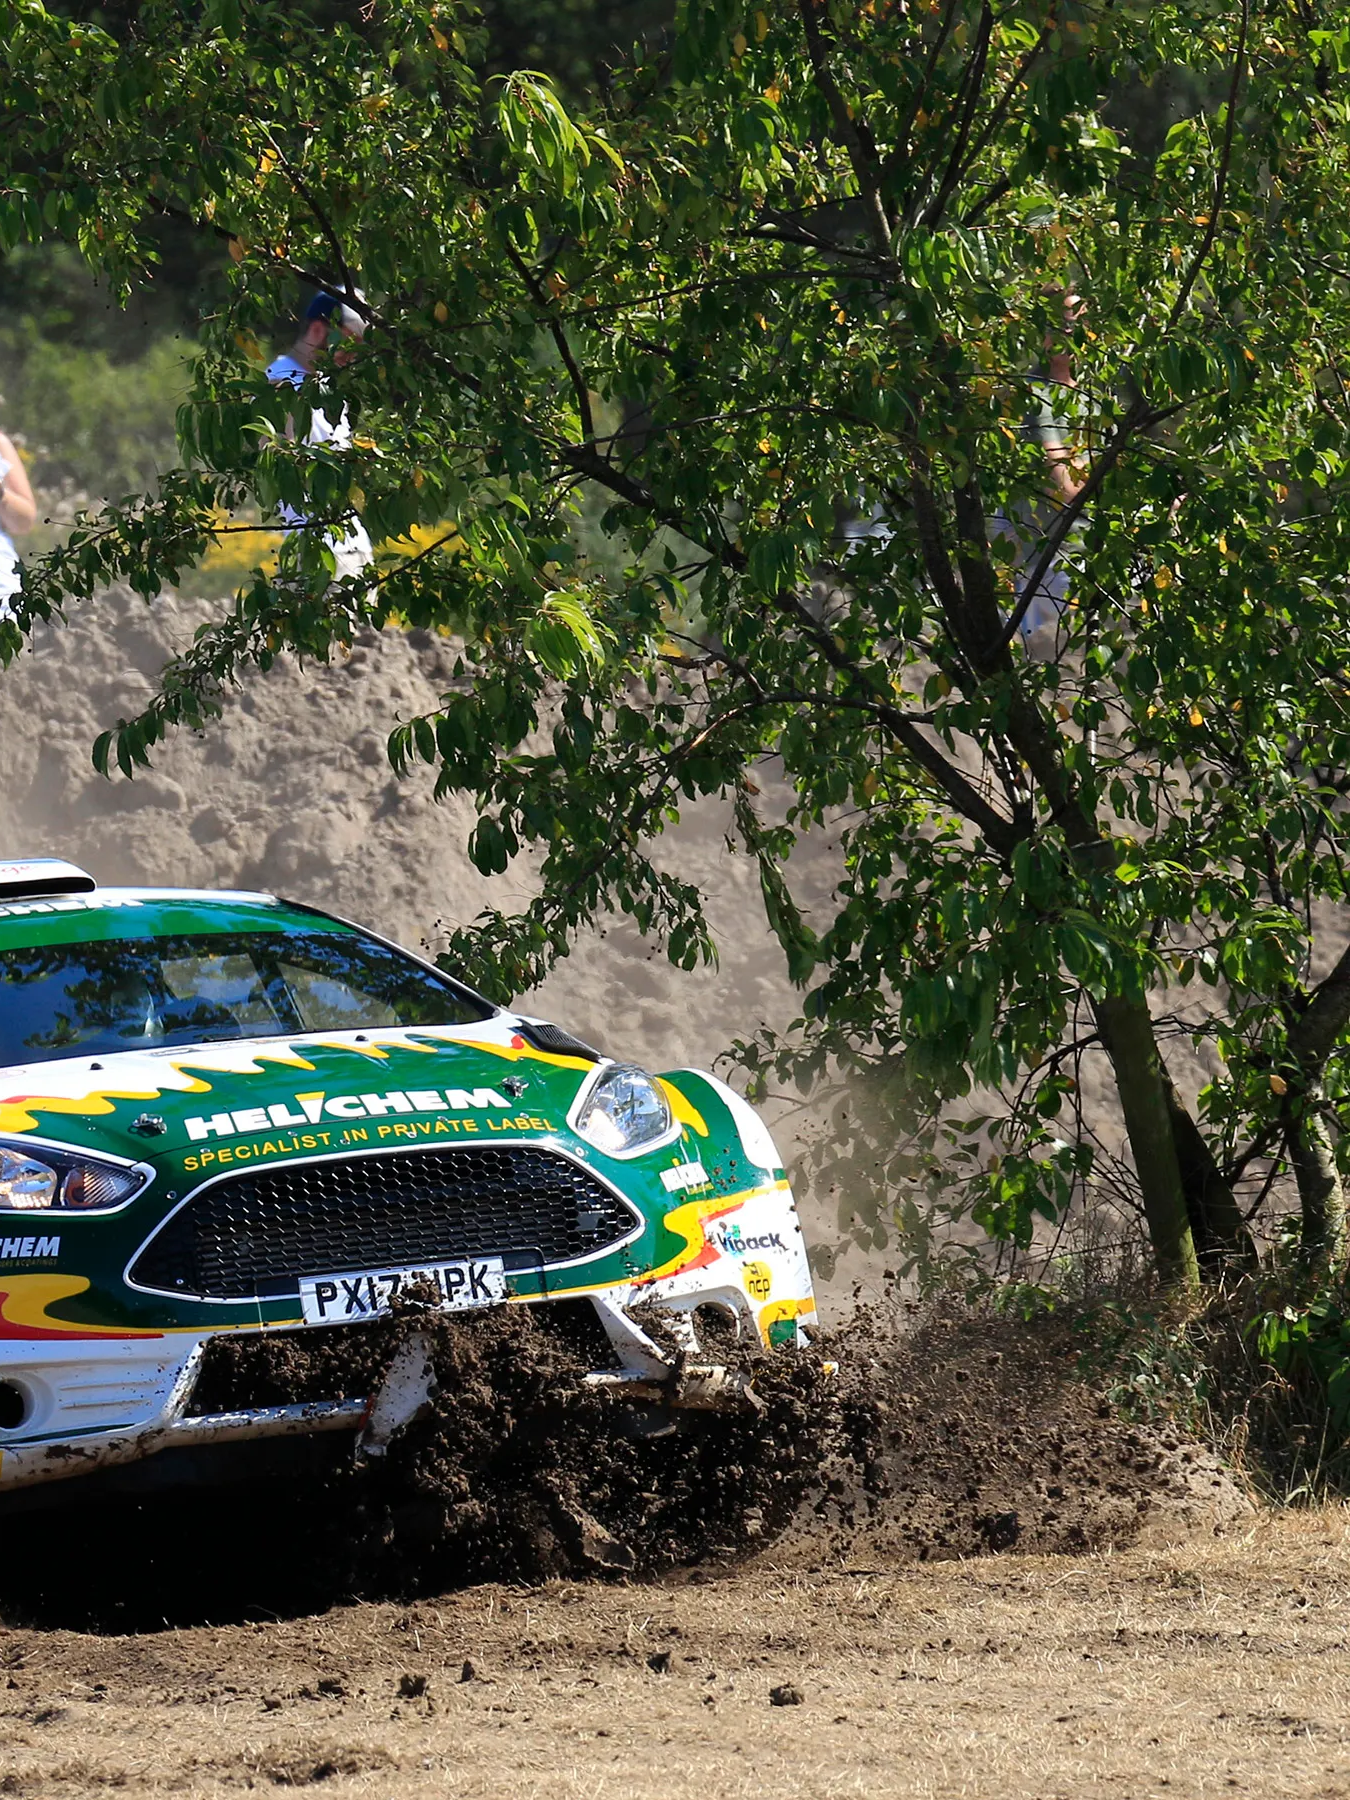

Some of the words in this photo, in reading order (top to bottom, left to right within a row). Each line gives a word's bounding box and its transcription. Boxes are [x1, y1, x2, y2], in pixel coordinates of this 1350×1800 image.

[184, 1088, 512, 1141] HELICHEM
[183, 1131, 334, 1172] SPECIALIST
[343, 1127, 368, 1144] IN
[377, 1118, 479, 1139] PRIVATE
[490, 1116, 558, 1134] LABEL
[749, 1278, 770, 1300] ncp
